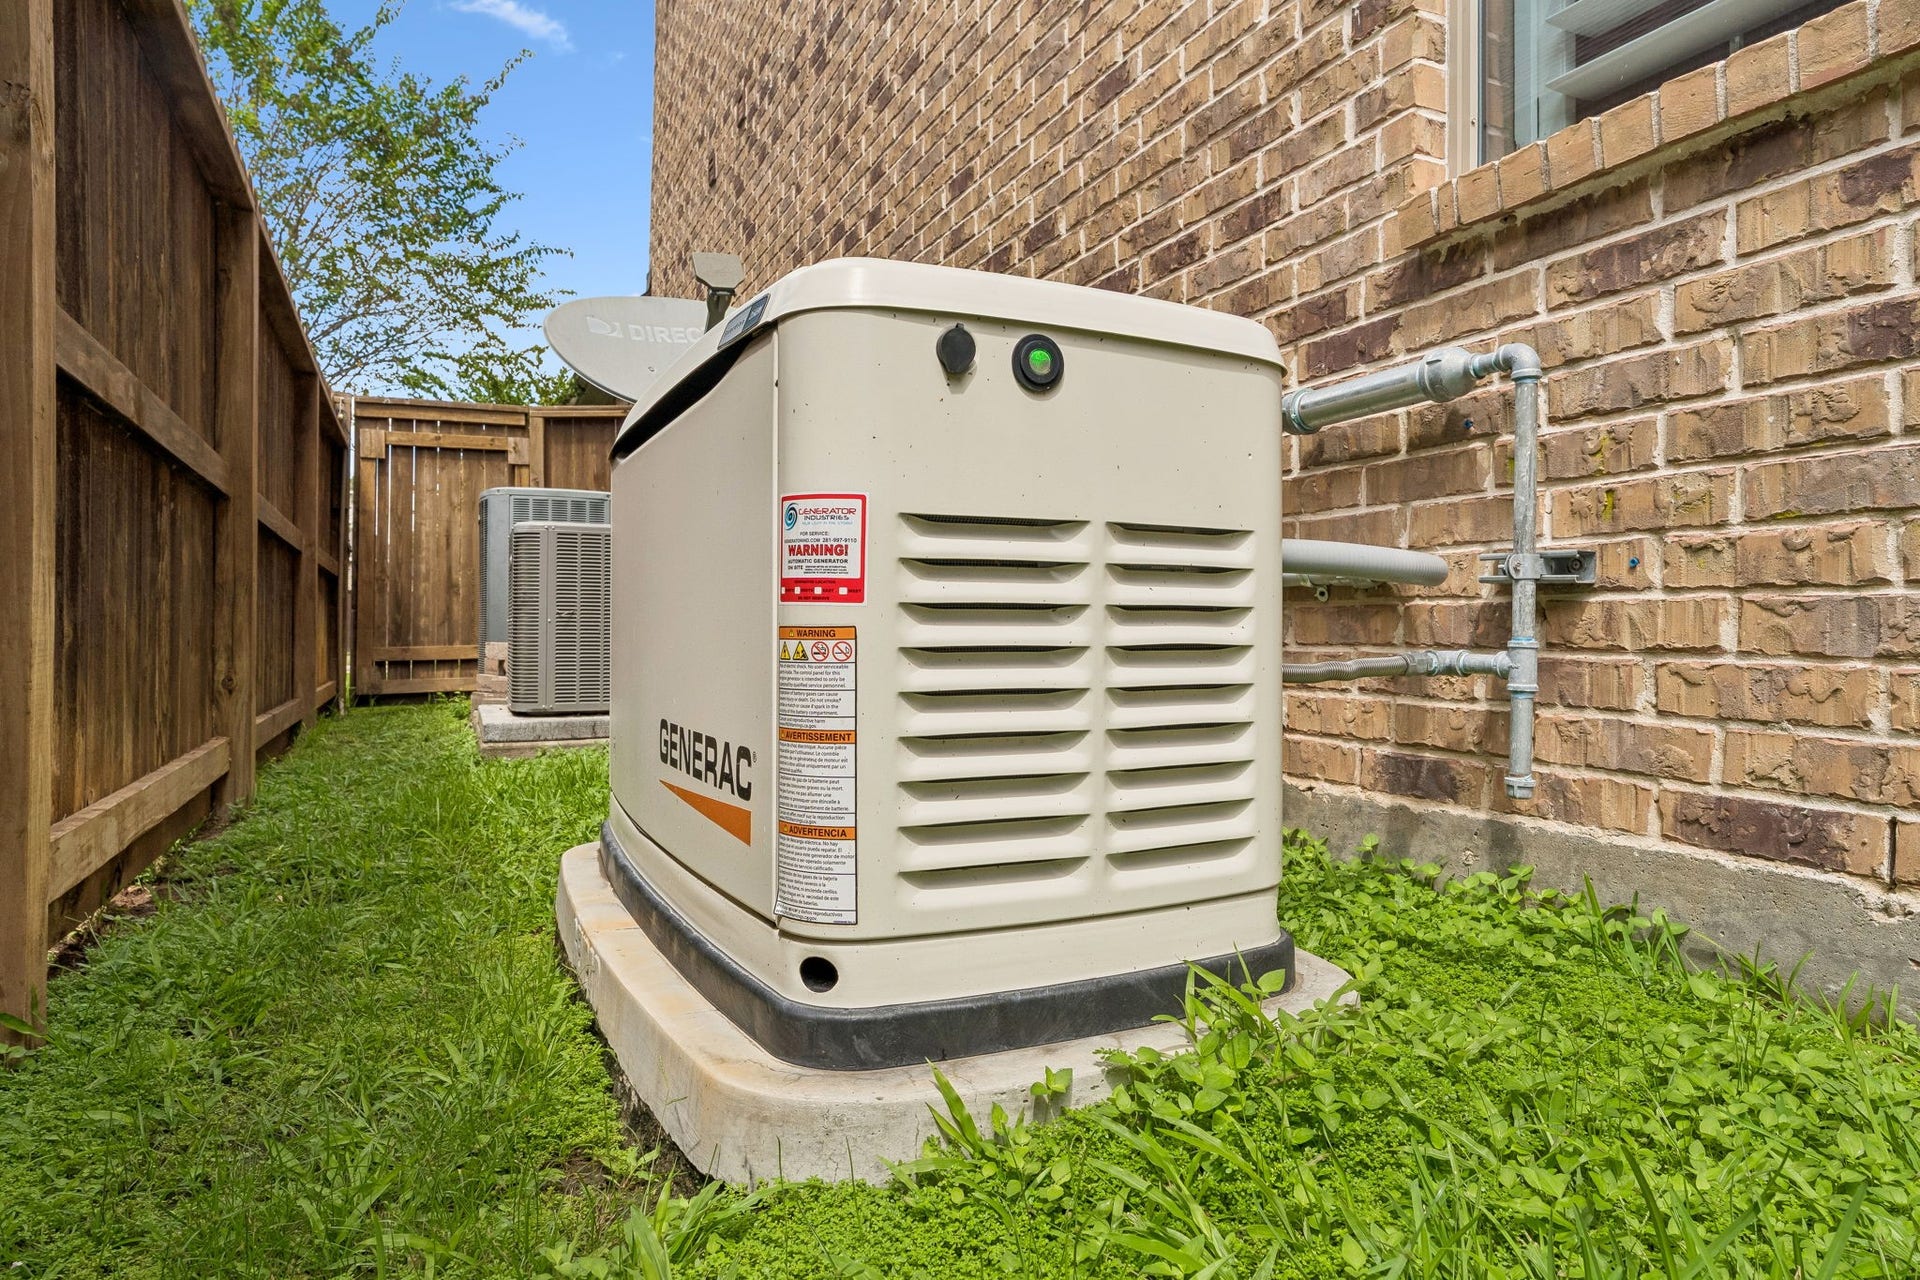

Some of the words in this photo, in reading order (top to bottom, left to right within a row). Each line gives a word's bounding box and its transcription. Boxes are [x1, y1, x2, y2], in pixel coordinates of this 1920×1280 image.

[628, 323, 704, 344] DIREC
[788, 544, 849, 556] WARNING!
[786, 731, 851, 741] AVERTISSEMENT
[659, 718, 752, 801] GENERAC
[789, 825, 847, 837] ADVERTENCIA
